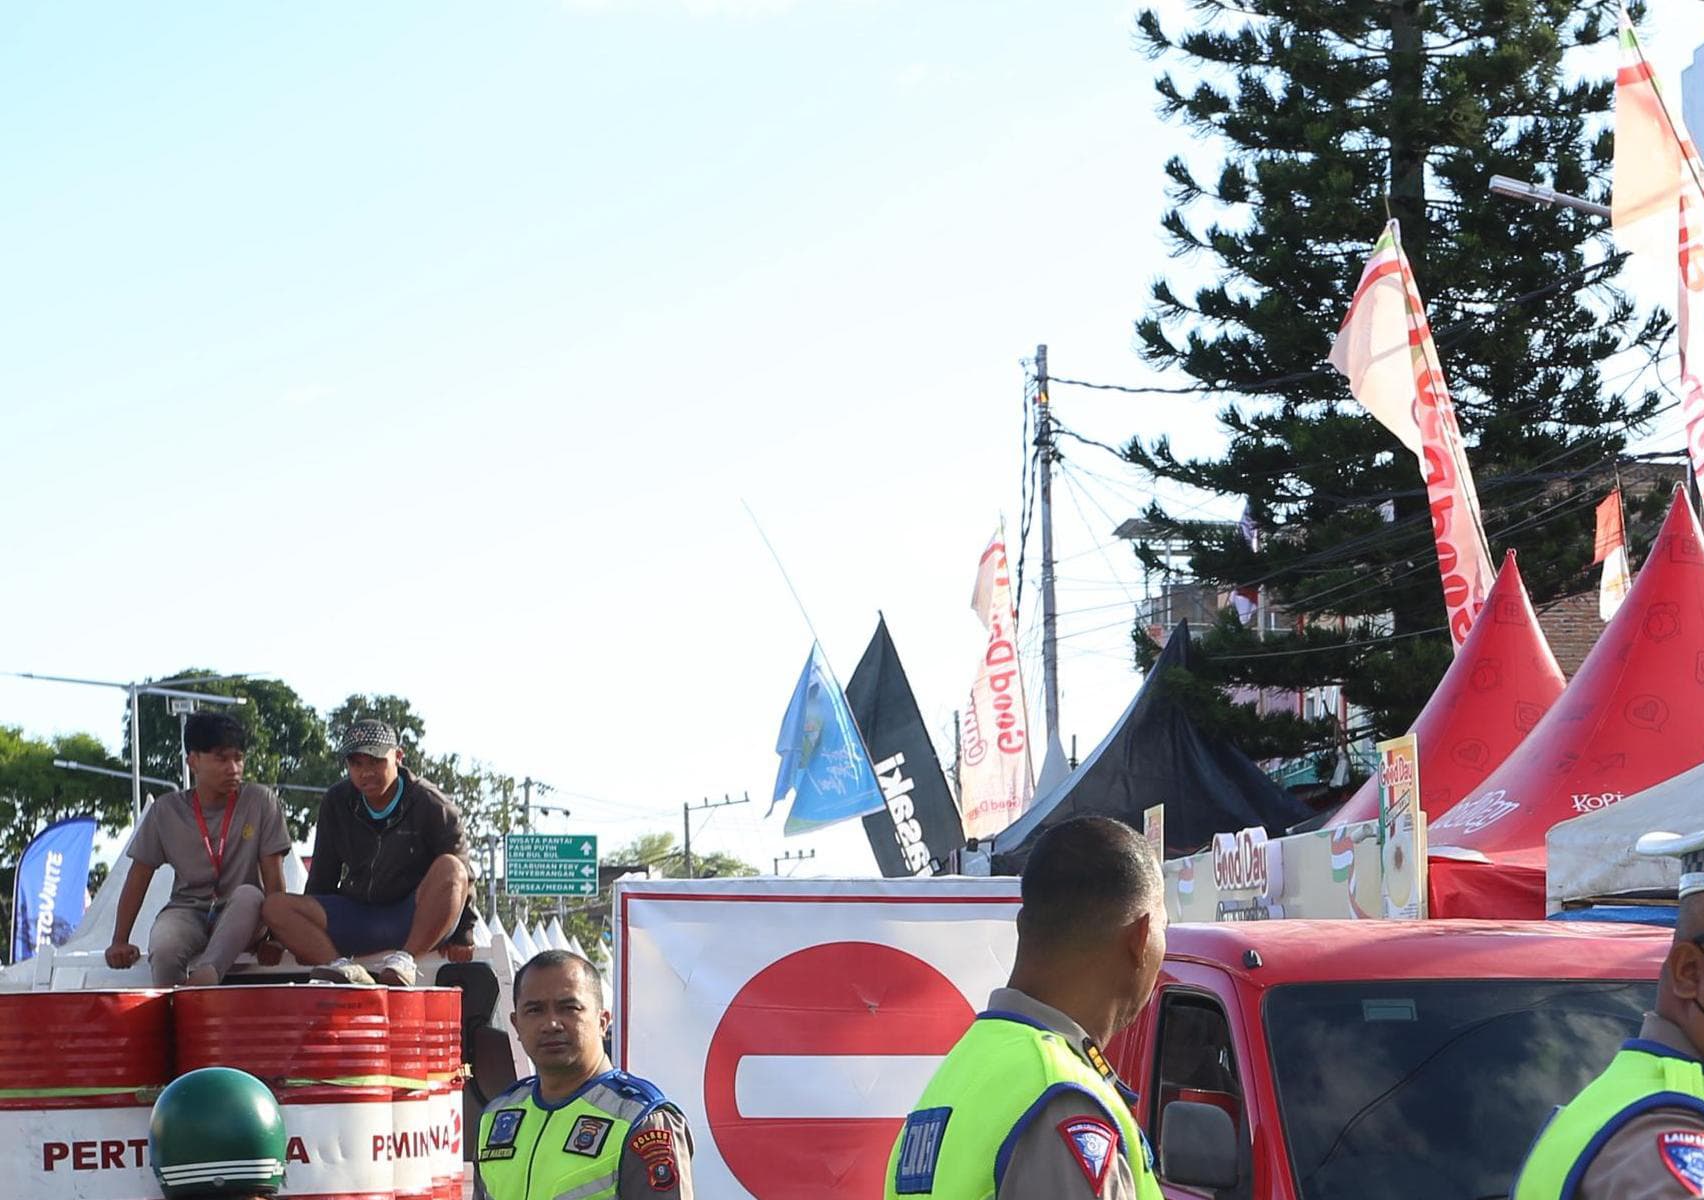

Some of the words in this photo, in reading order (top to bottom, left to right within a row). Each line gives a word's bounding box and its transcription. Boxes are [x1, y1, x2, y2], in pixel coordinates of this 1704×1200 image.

[542, 837, 573, 845] PANTAI
[1213, 832, 1242, 888] Good
[1243, 832, 1268, 894] Day
